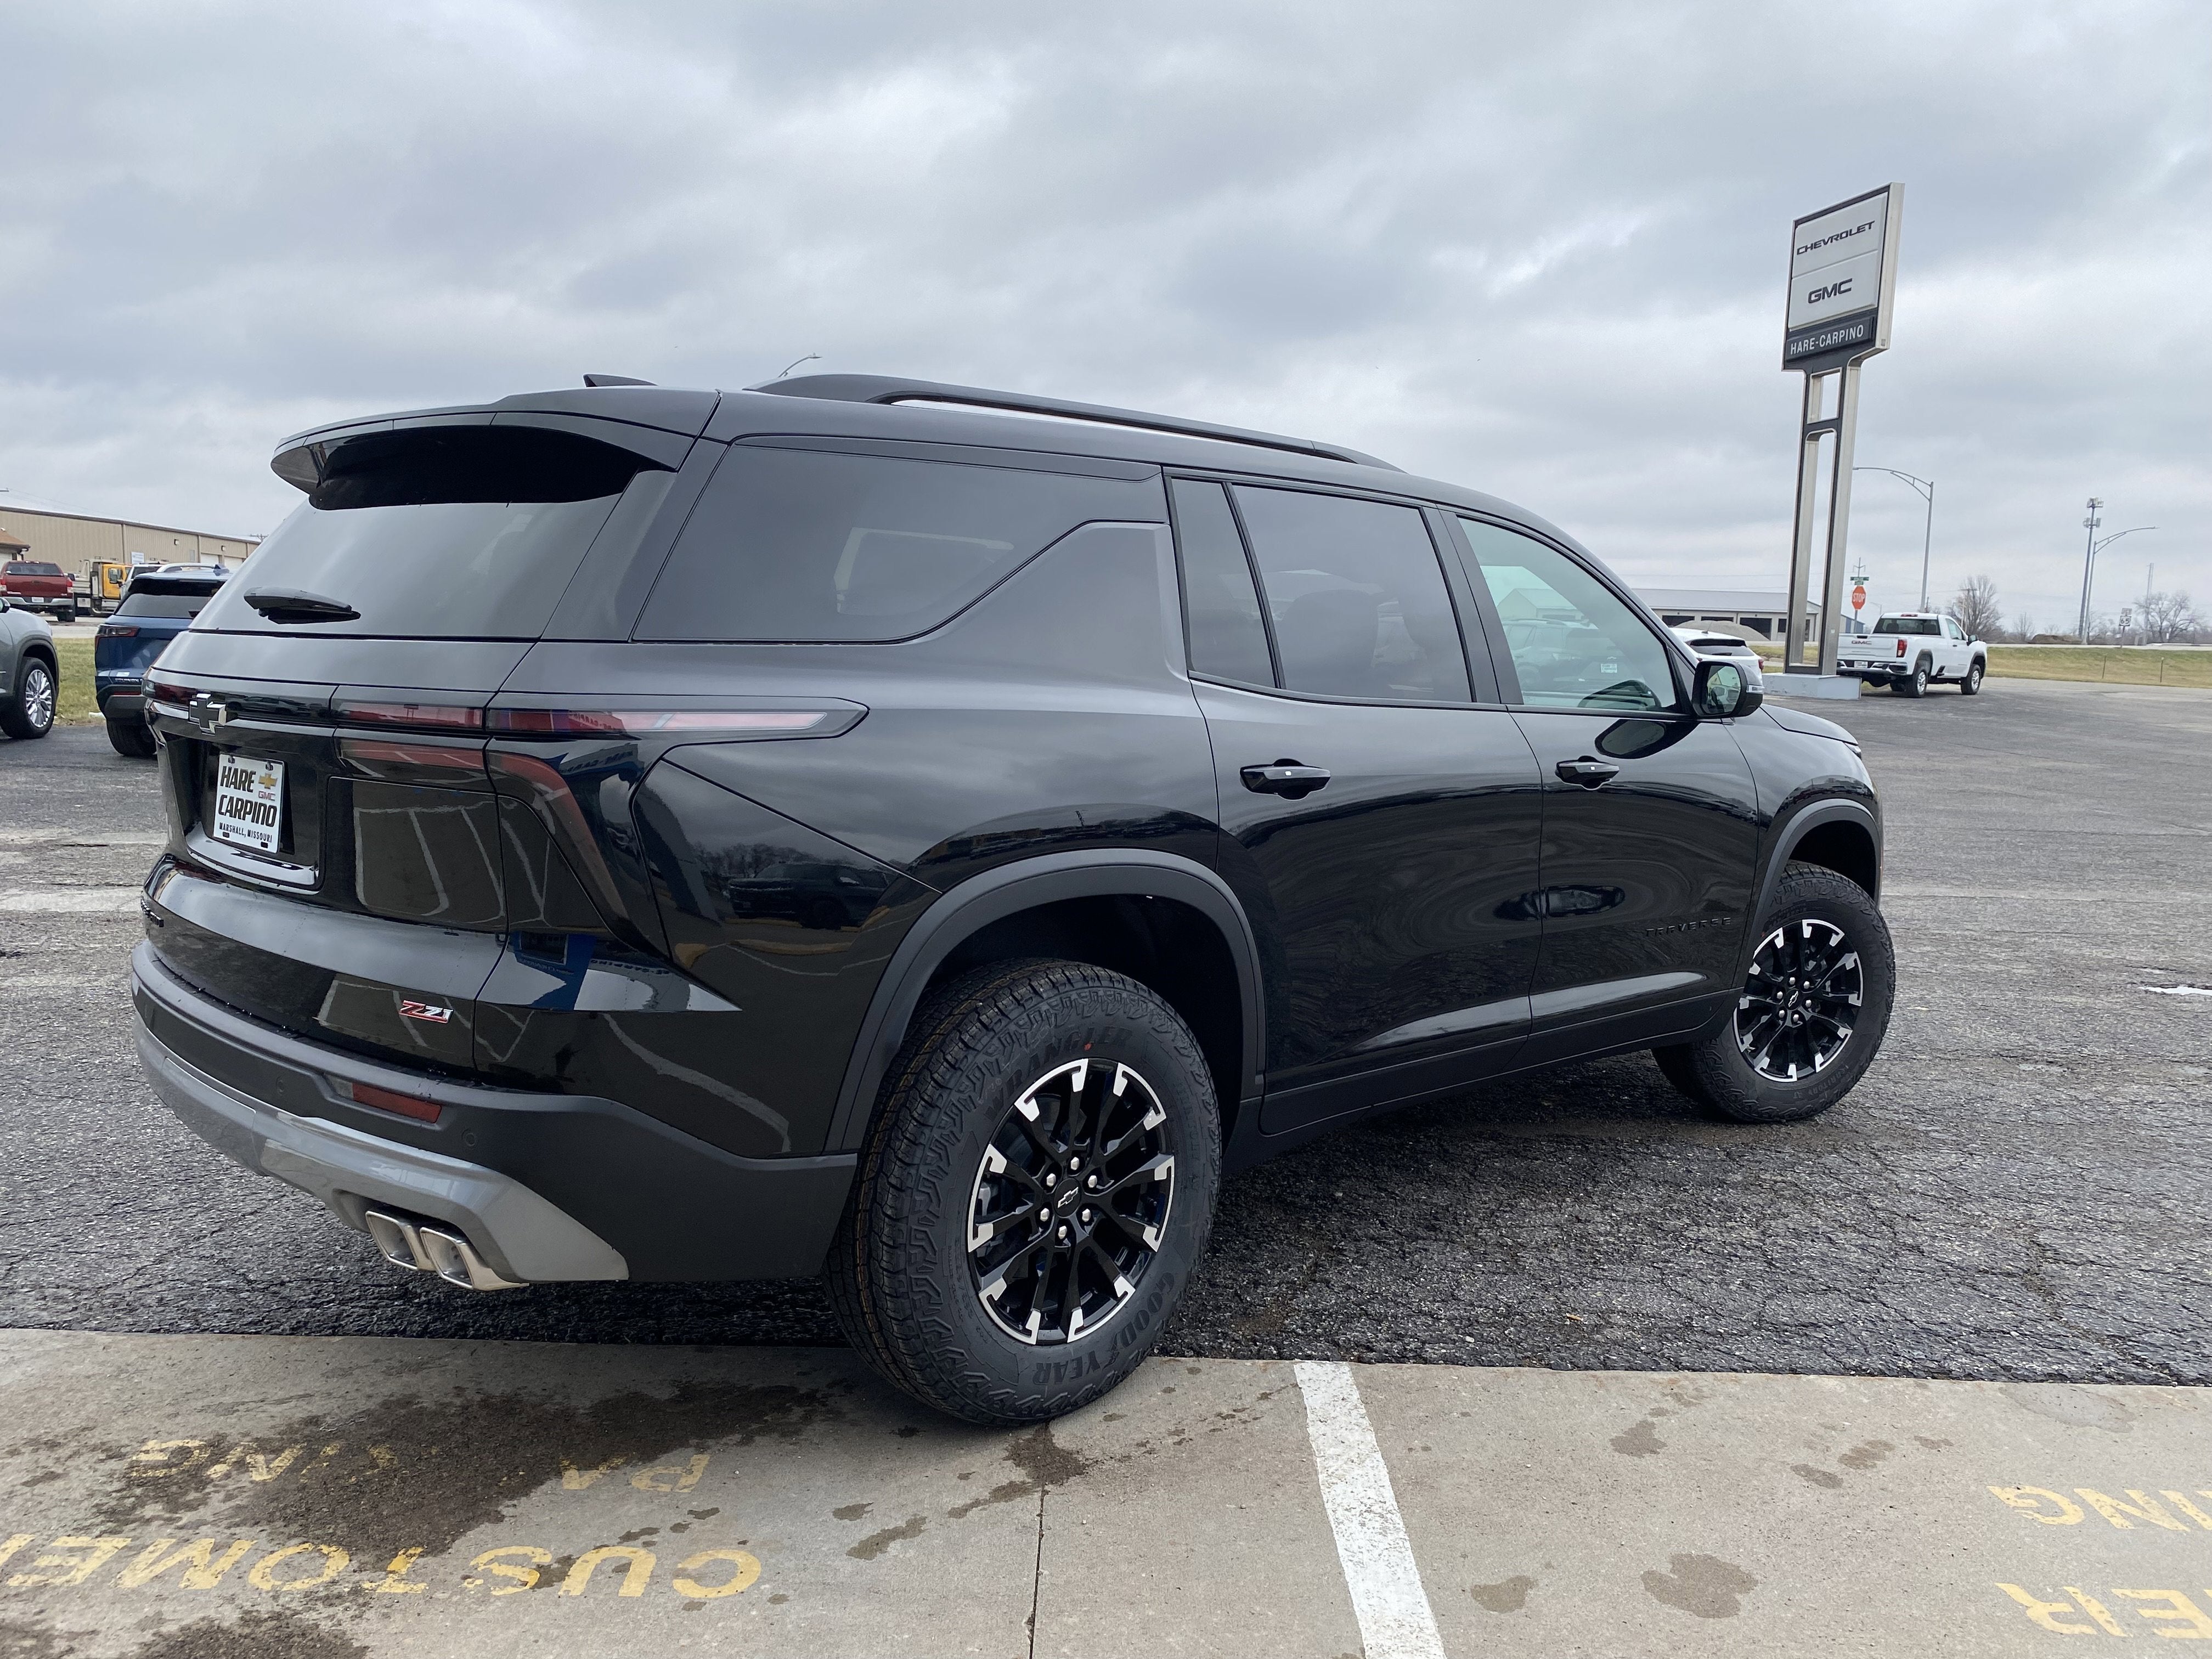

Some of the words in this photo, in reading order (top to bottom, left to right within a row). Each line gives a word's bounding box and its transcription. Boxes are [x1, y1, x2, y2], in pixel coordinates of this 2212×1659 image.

[1797, 221, 1875, 255] CHEVROLET
[1808, 278, 1853, 304] GMC
[1790, 324, 1864, 355] HARE-CARPINO
[1853, 593, 1865, 602] STOP
[220, 766, 256, 793] HARE
[258, 791, 275, 801] GMC
[218, 794, 277, 827] CARPINO
[219, 822, 246, 837] MARSHALL,
[247, 829, 273, 843] MISSOURI
[1646, 917, 1731, 936] TRAVERSE
[399, 1000, 454, 1024] Z71
[1986, 1485, 2212, 1532] ING
[1995, 1582, 2212, 1639] ER
